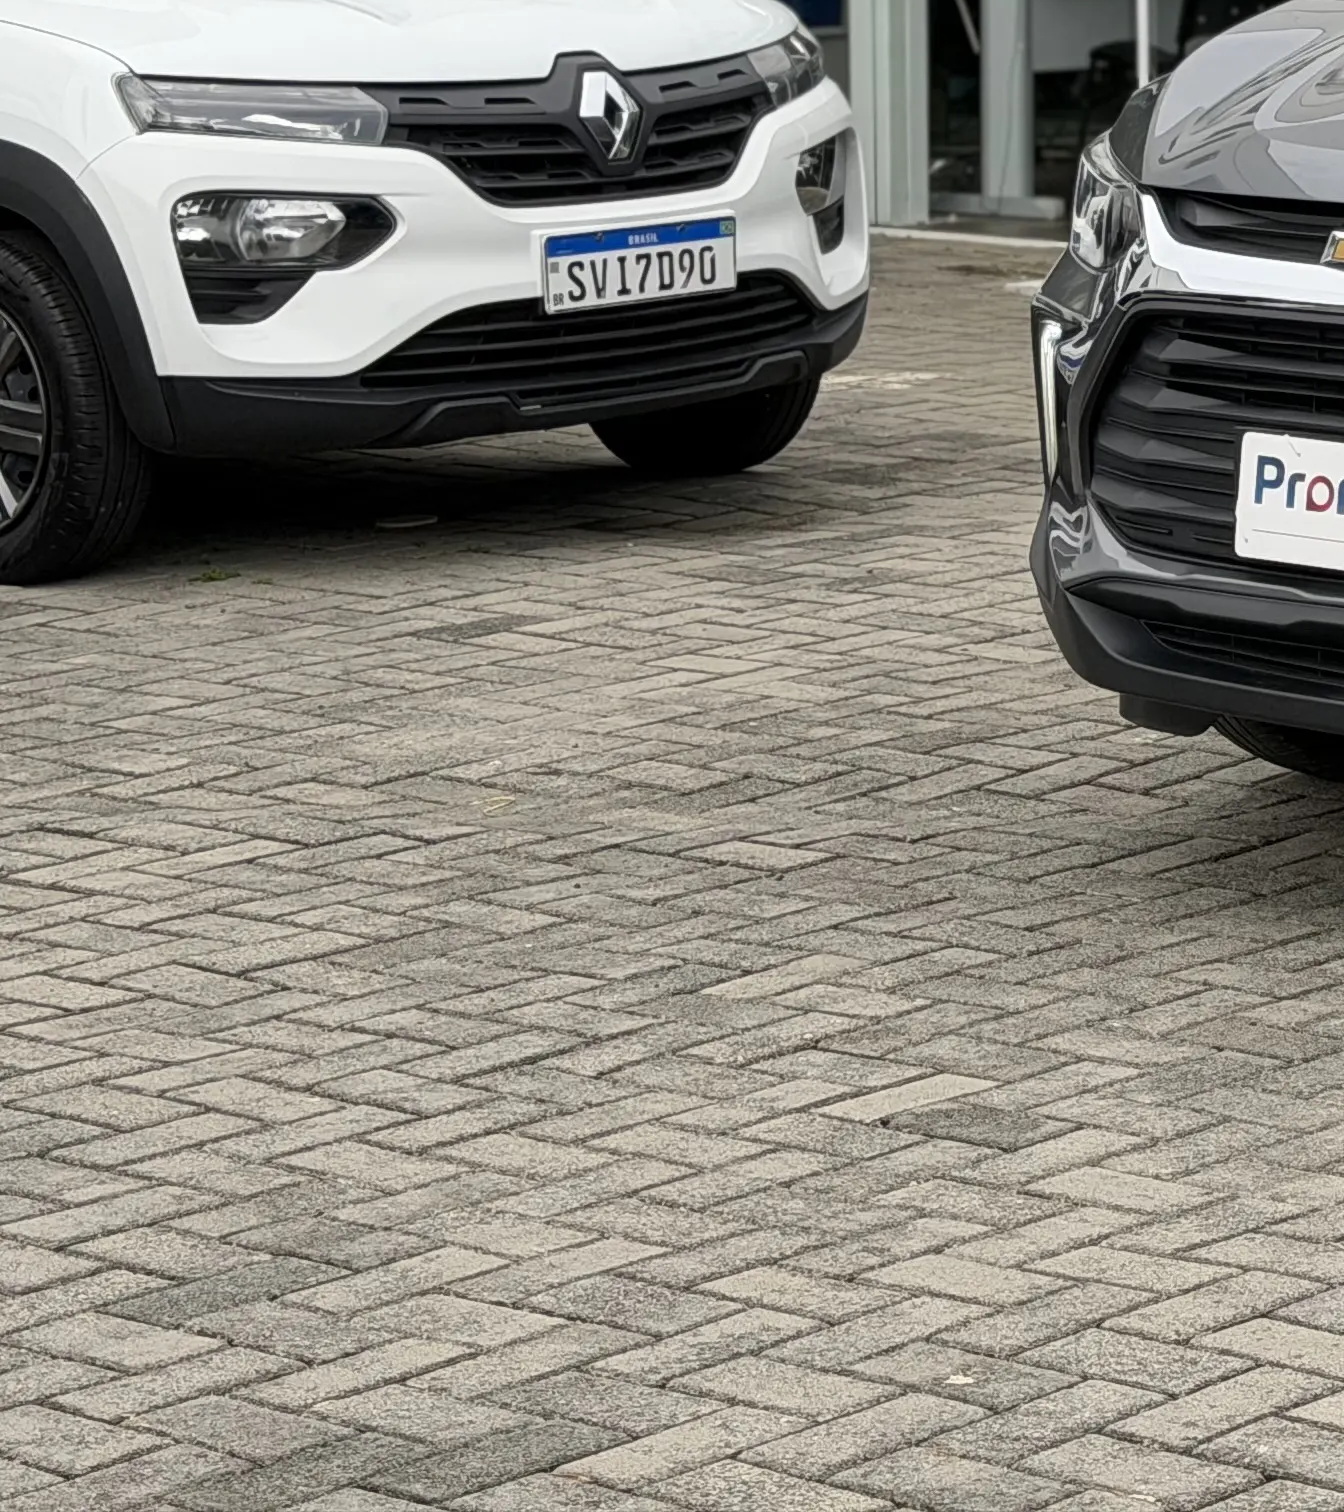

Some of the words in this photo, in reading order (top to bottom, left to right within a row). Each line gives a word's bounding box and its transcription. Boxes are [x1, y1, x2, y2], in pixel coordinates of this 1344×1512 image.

[627, 233, 659, 246] BRASIL
[567, 245, 717, 303] SVI7D90
[553, 292, 565, 306] BR
